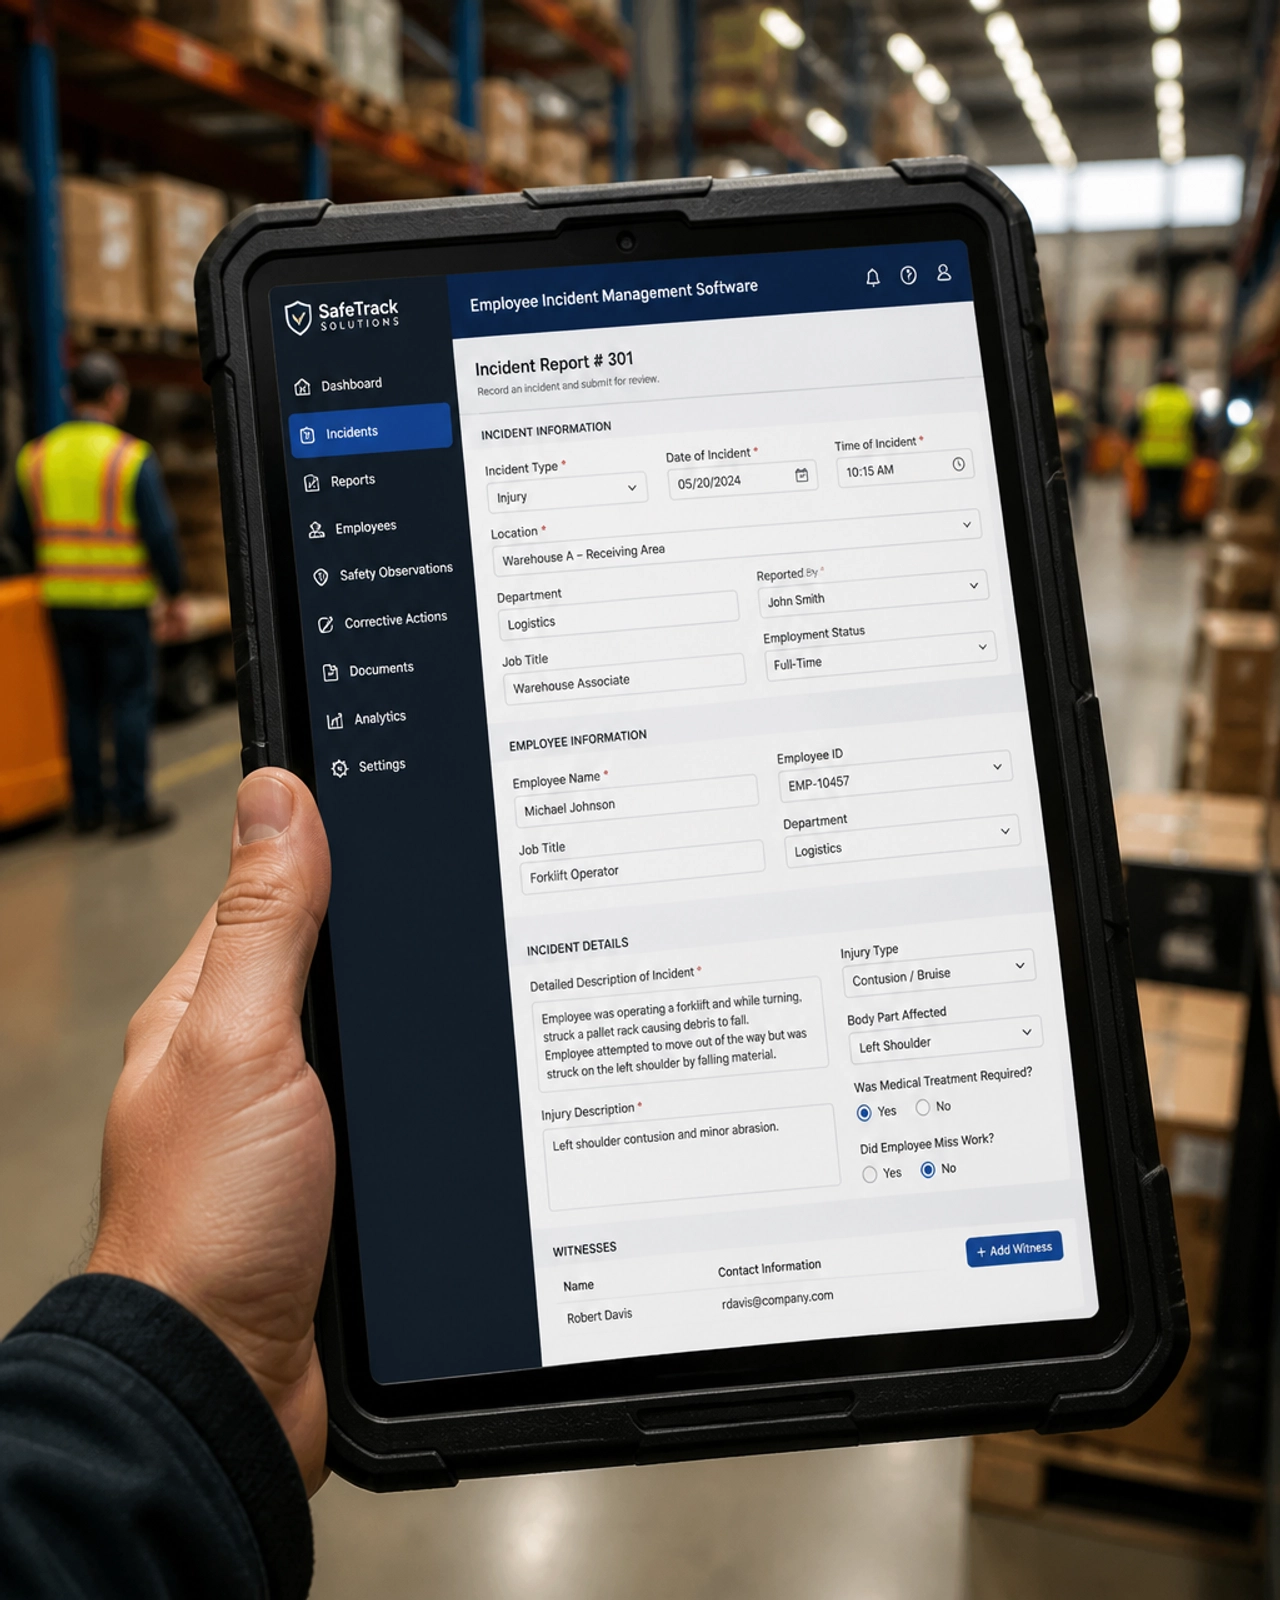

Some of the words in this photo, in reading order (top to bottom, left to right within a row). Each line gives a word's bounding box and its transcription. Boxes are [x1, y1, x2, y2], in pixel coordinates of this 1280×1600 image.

[470, 296, 538, 313] Employee
[542, 291, 599, 307] Incident
[602, 284, 692, 303] Management
[695, 280, 758, 296] Software
[318, 299, 398, 319] SafeTrack
[320, 316, 399, 331] SOLUTIONS
[475, 359, 536, 376] Incident
[540, 355, 590, 374] Report
[593, 353, 603, 367] #
[607, 351, 633, 366] 301
[321, 376, 382, 392] Dashboard
[477, 385, 509, 396] Record
[511, 386, 522, 394] an
[524, 382, 560, 392] incident
[562, 379, 579, 390] and
[613, 376, 626, 386] for
[628, 374, 659, 385] review.
[326, 426, 378, 439] Incidents
[481, 427, 533, 440] INCIDENT
[536, 421, 611, 436] INFORMATION
[834, 440, 860, 451] Time
[862, 438, 873, 450] of
[875, 436, 917, 448] Incident
[666, 452, 691, 463] Date
[693, 449, 705, 461] of
[707, 447, 751, 460] Incident
[485, 463, 529, 476] Incident
[531, 461, 558, 474] Type
[846, 465, 874, 477] 10:15
[877, 464, 894, 475] AM
[331, 474, 375, 488] Reports
[677, 474, 741, 490] 05/20/2024
[497, 491, 527, 505] Injury
[335, 521, 397, 535] Employees
[490, 526, 538, 540] Location
[502, 553, 563, 566] Warehouse
[566, 550, 574, 561] A
[586, 545, 638, 559] Receiving
[640, 544, 665, 554] Area
[340, 568, 376, 581] Safety
[378, 562, 453, 578] Observations
[756, 567, 804, 583] Reported
[496, 588, 562, 605] Department
[767, 596, 793, 608] John
[794, 592, 825, 605] Smith
[344, 614, 403, 629] Corrective
[405, 611, 448, 624] Actions
[507, 616, 556, 632] Logistics
[763, 628, 829, 645] Employment
[831, 627, 865, 638] Status
[502, 655, 522, 667] Job
[524, 653, 548, 665] Title
[773, 657, 822, 670] Full-Time
[349, 662, 414, 677] Documents
[512, 680, 574, 694] Warehouse
[577, 674, 630, 688] Associate
[354, 710, 406, 726] Analytics
[509, 736, 568, 752] EMPLOYEE
[570, 729, 647, 746] INFORMATION
[777, 751, 829, 765] Employee
[831, 747, 843, 759] ID
[359, 759, 406, 773] Settings
[512, 776, 566, 790] Employee
[568, 772, 600, 784] Name
[788, 774, 849, 792] EMP-10457
[524, 802, 567, 816] Michael
[569, 800, 615, 813] Johnson
[783, 814, 847, 831] Department
[518, 843, 539, 856] Job
[541, 841, 566, 853] Title
[794, 842, 842, 858] Logistics
[570, 866, 618, 882] Operator
[527, 941, 580, 956] INCIDENT
[582, 936, 629, 951] DETAILS
[840, 947, 871, 961] Injury
[872, 944, 898, 958] Type
[529, 977, 574, 992] Detailed
[576, 972, 637, 988] Description
[638, 969, 650, 982] of
[652, 967, 694, 980] Incident
[852, 972, 907, 987] Contusion
[917, 967, 951, 981] Bruise
[541, 1012, 591, 1025] Employee
[593, 1009, 615, 1019] was
[616, 1003, 666, 1019] operating
[667, 1004, 674, 1013] a
[712, 997, 731, 1009] and
[733, 994, 760, 1007] while
[847, 1013, 875, 1026] Body
[877, 1011, 899, 1023] Part
[902, 1006, 947, 1020] Affected
[543, 1029, 575, 1043] struck
[577, 1031, 584, 1039] a
[586, 1026, 615, 1041] pallet
[616, 1024, 639, 1036] rack
[641, 1021, 682, 1034] causing
[682, 1017, 716, 1030] debris
[717, 1017, 729, 1027] to
[729, 1014, 749, 1026] fall.
[544, 1048, 594, 1062] Employee
[596, 1041, 649, 1056] attempted
[651, 1041, 663, 1051] to
[664, 1039, 693, 1050] move
[695, 1037, 712, 1048] out
[714, 1033, 725, 1046] of
[726, 1033, 744, 1045] the
[745, 1033, 766, 1044] way
[767, 1029, 785, 1041] but
[786, 1029, 807, 1039] was
[859, 1041, 880, 1053] Left
[883, 1037, 931, 1051] Shoulder
[546, 1066, 579, 1079] struck
[581, 1067, 595, 1076] on
[596, 1063, 614, 1075] the
[616, 1061, 633, 1073] left
[635, 1057, 680, 1071] shoulder
[682, 1056, 695, 1069] by
[697, 1053, 730, 1066] falling
[731, 1048, 776, 1062] material.
[853, 1082, 877, 1093] Was
[879, 1076, 921, 1090] Medical
[923, 1072, 977, 1086] Treatment
[980, 1065, 1033, 1082] Required?
[541, 1108, 572, 1122] Injury
[574, 1102, 635, 1118] Description
[877, 1105, 897, 1117] Yes
[936, 1101, 951, 1111] No
[552, 1139, 573, 1151] Left
[575, 1135, 621, 1149] shoulder
[623, 1131, 675, 1145] contusion
[677, 1127, 697, 1140] and
[699, 1126, 730, 1137] minor
[731, 1121, 779, 1135] abrasion.
[860, 1142, 878, 1155] Did
[880, 1140, 932, 1153] Employee
[934, 1136, 959, 1148] Miss
[961, 1132, 994, 1145] Work?
[882, 1167, 902, 1178] Yes
[941, 1163, 956, 1174] No
[552, 1241, 617, 1257] WITNESSES
[990, 1244, 1011, 1256] Add
[1012, 1242, 1053, 1254] Witness
[717, 1264, 759, 1278] Contact
[761, 1259, 821, 1273] Information
[563, 1281, 594, 1292] Name
[722, 1291, 834, 1310] rdavis@company.com
[567, 1311, 602, 1324] Robert
[604, 1307, 633, 1321] Davis
